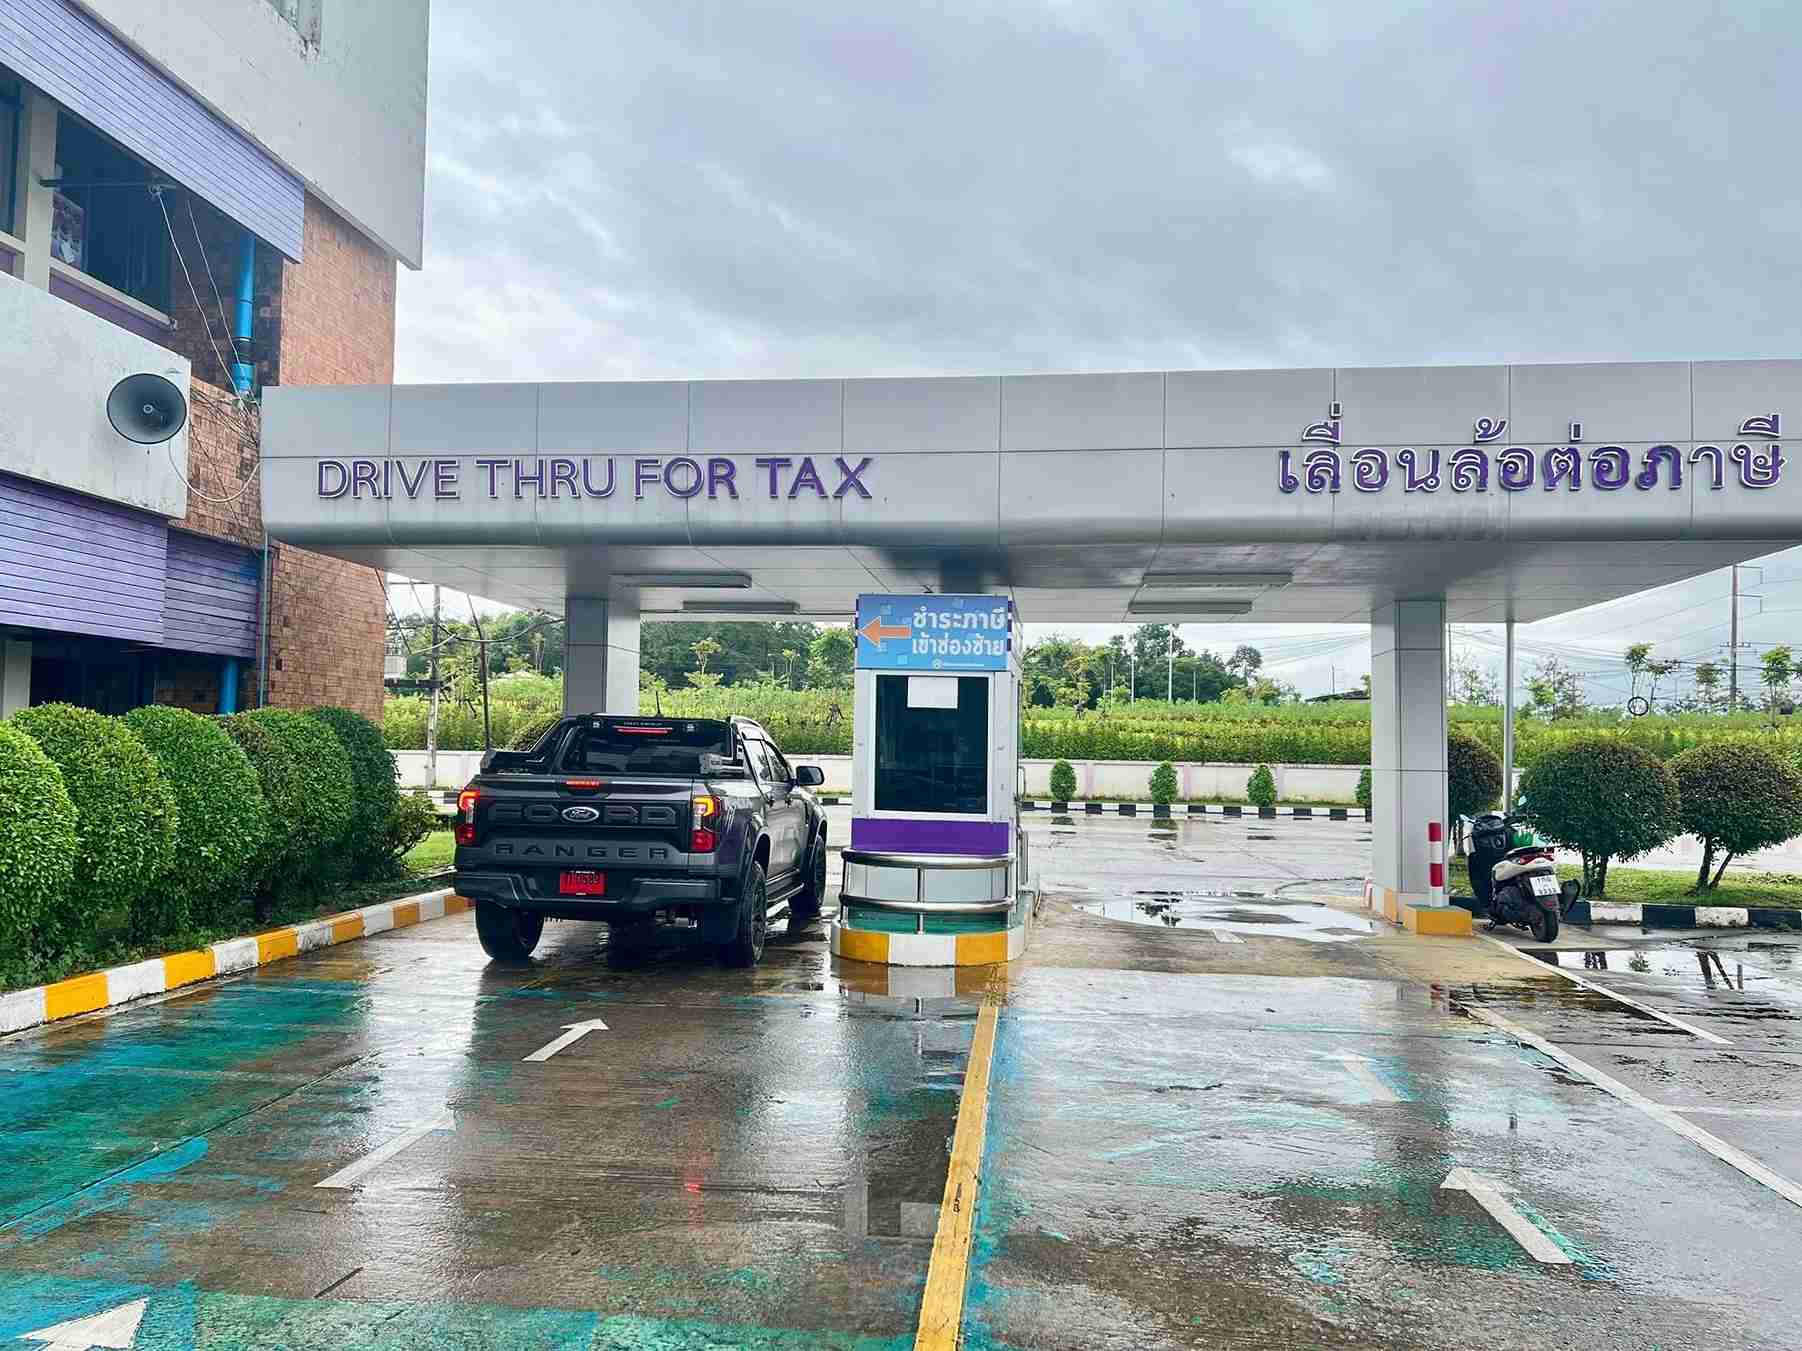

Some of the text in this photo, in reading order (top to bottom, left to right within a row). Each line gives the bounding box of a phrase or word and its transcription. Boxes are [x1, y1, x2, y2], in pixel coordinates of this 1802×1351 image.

[1279, 401, 1785, 492] เลื่อนล้อต่อภาษี
[317, 457, 873, 499] DRIVE THRU FOR TAX
[913, 606, 1005, 629] ชำระภาษี
[496, 844, 668, 860] RANGER
